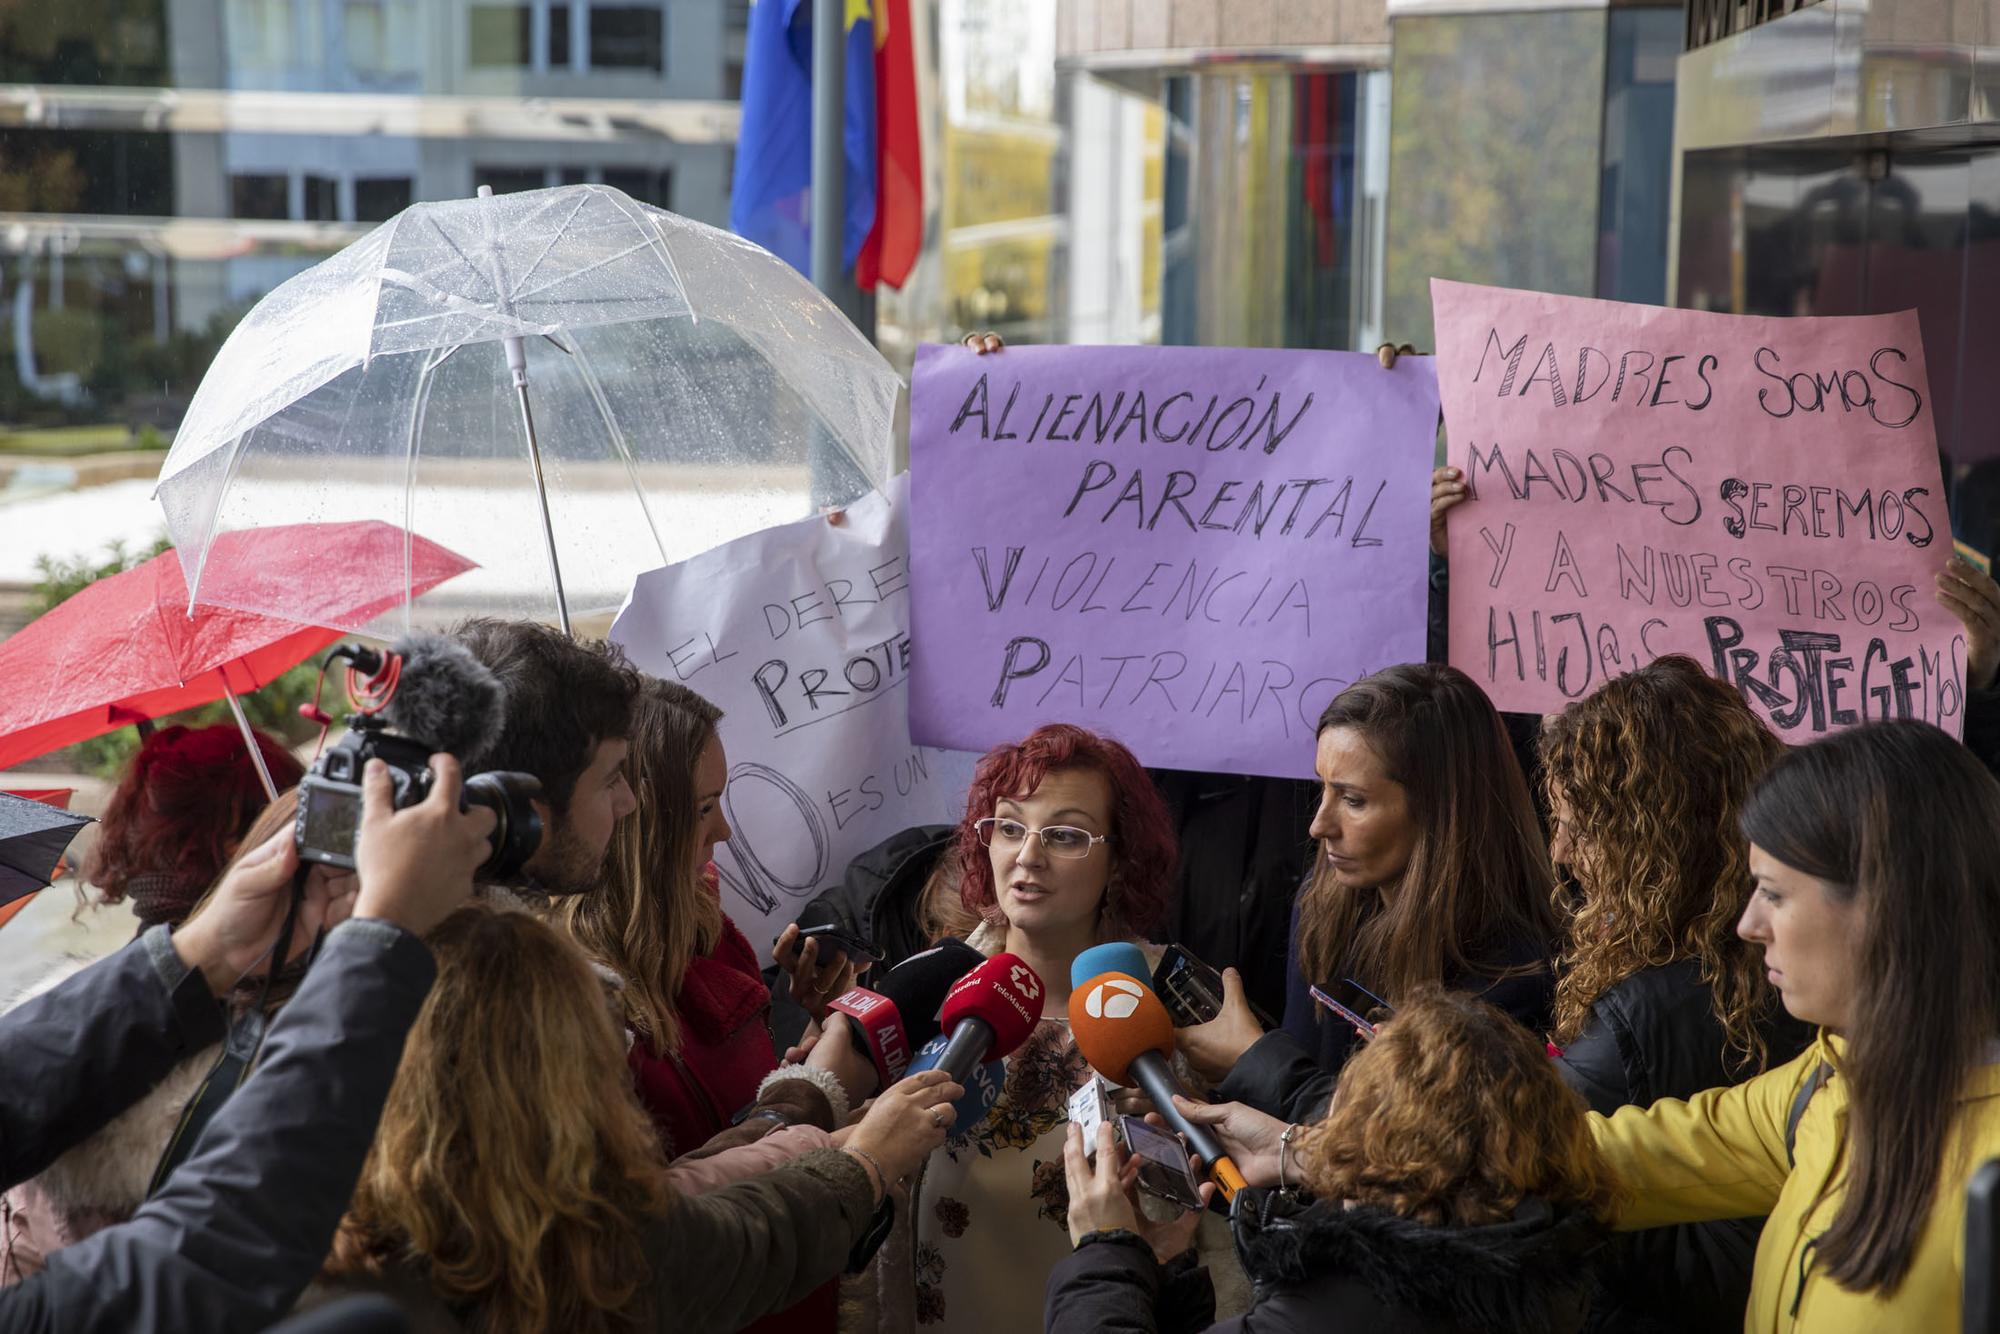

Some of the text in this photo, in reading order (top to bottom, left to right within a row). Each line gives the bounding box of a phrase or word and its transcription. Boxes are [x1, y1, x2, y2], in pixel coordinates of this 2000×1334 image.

[950, 373, 1314, 455] ALIENACIÓN
[1473, 327, 1718, 411] MADRES
[1063, 459, 1388, 549] PARENTAL
[1465, 441, 1934, 548] MADRES SEREMOS
[666, 555, 910, 681] EL DERE
[971, 546, 1311, 638] VIOLENCIA
[1480, 522, 1921, 632] Y A NUESTROS
[990, 635, 1368, 738] PATRIARC
[828, 775, 884, 831] ES
[894, 744, 928, 797] UN
[920, 1040, 947, 1056] tv
